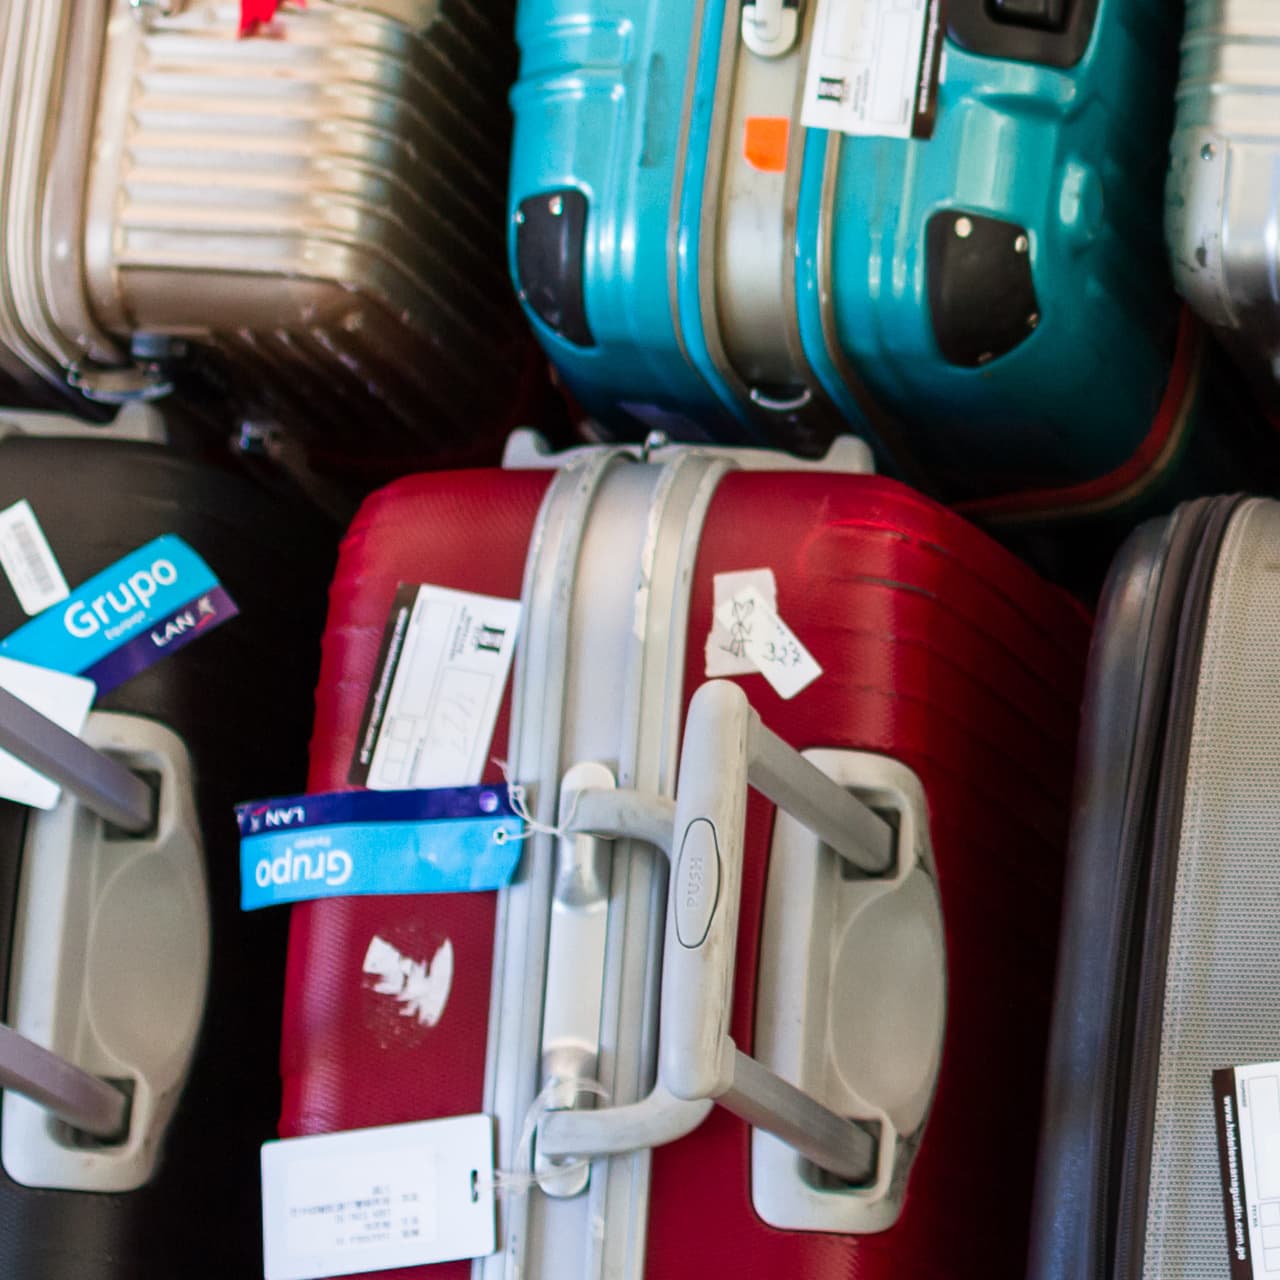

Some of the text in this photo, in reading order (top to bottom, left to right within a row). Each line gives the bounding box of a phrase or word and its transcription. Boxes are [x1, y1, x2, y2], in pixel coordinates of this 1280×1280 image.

[64, 559, 178, 639] Grupo
[151, 611, 196, 648] LAN
[265, 805, 306, 827] LAN
[255, 847, 353, 888] Grupo
[685, 856, 703, 910] PUSH
